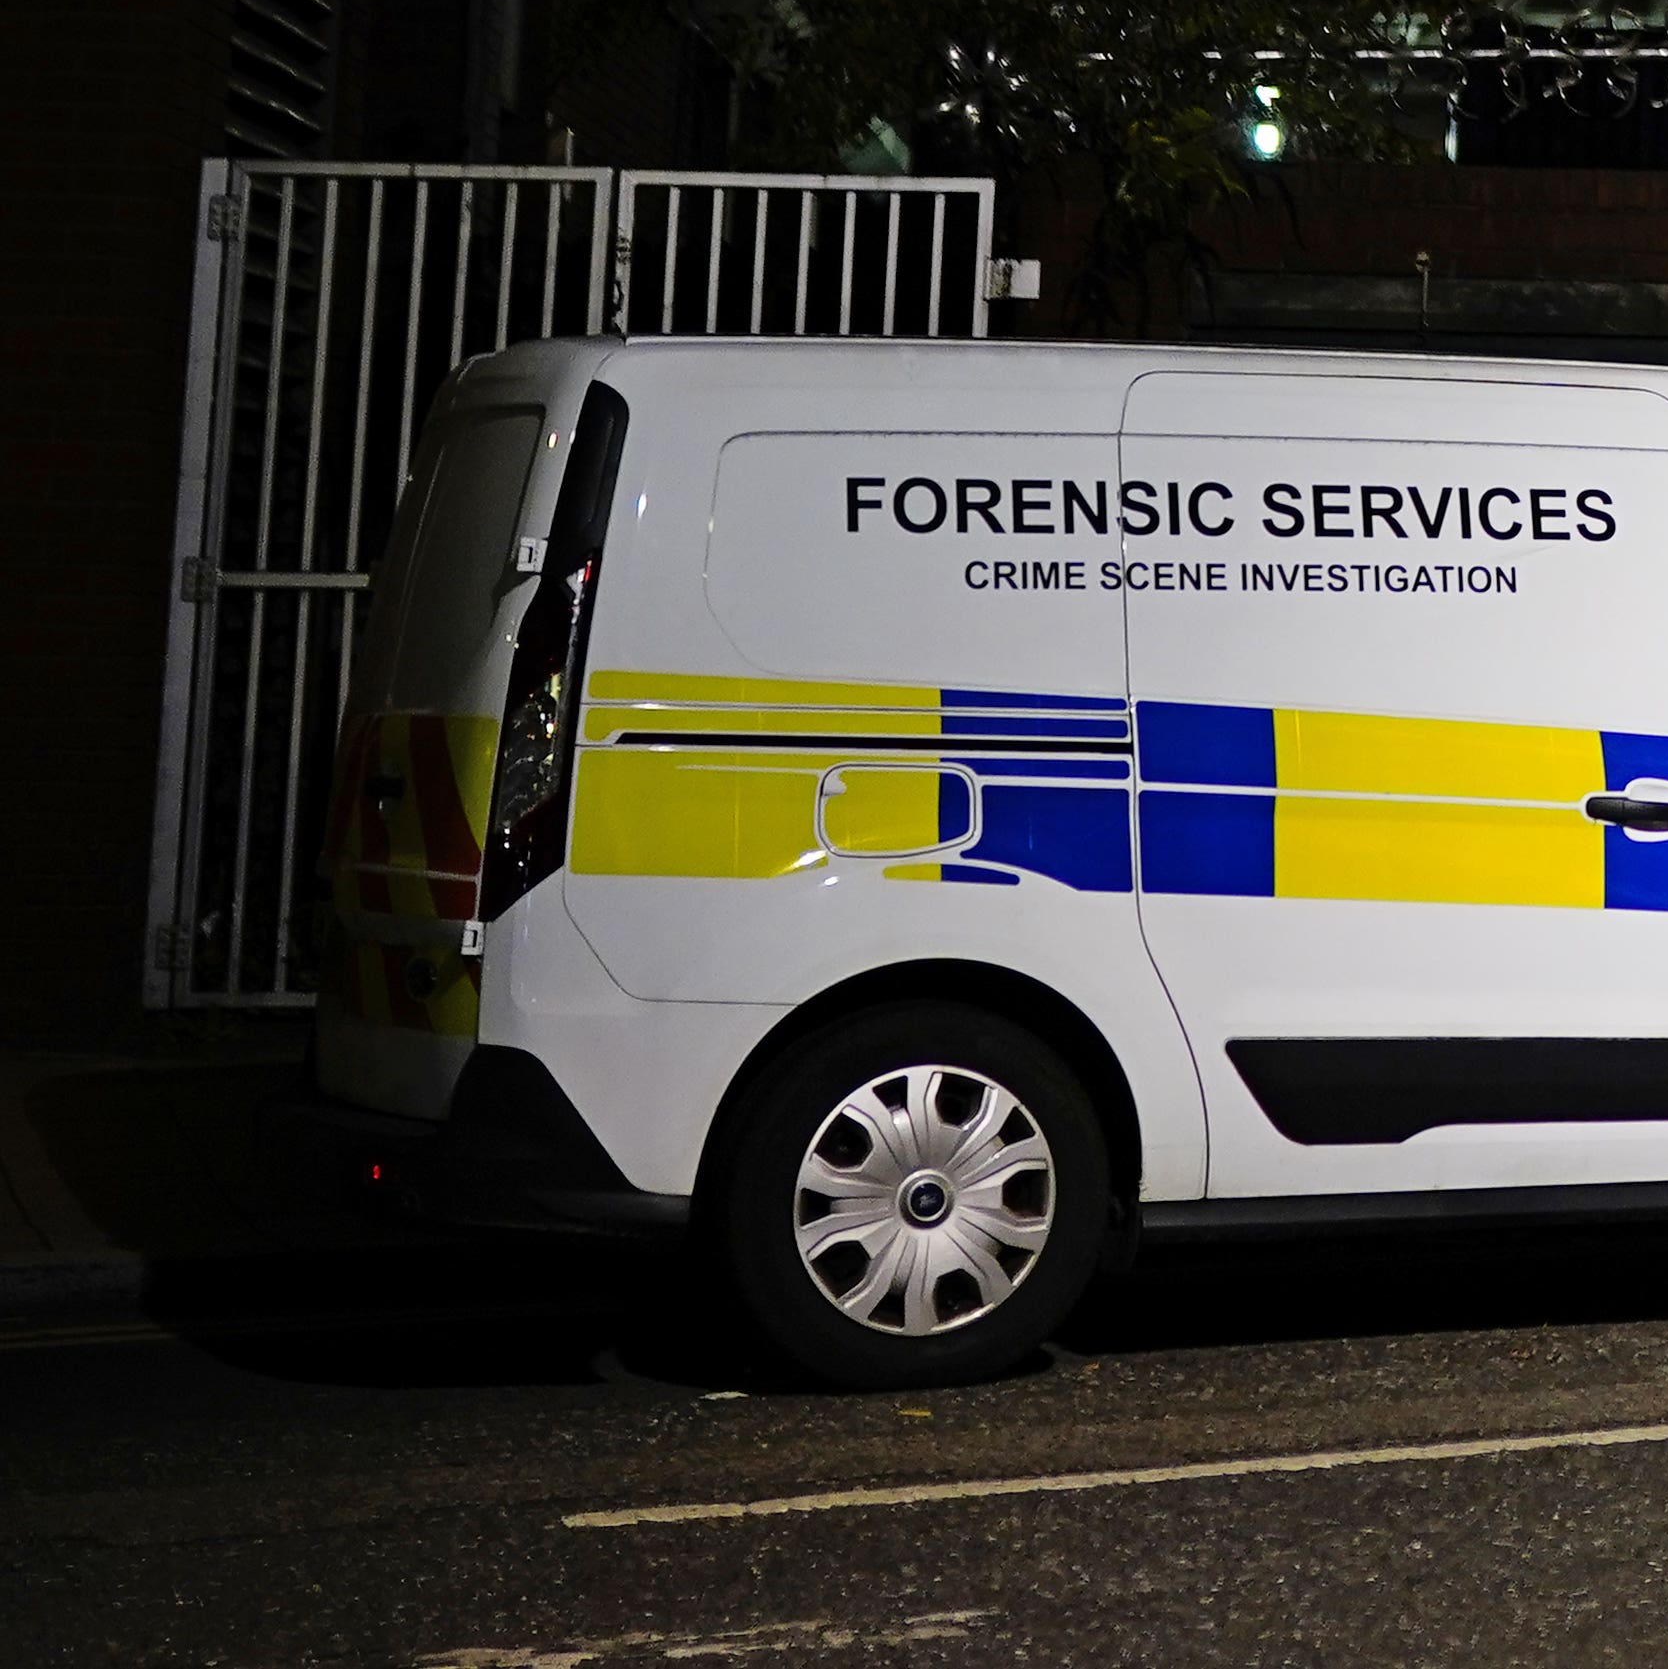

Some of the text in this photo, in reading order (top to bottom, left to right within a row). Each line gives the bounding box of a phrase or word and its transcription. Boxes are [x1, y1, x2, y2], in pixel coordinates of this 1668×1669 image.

[846, 477, 1616, 541] FORENSIC SERVICES
[963, 559, 1519, 595] CRIME SCENE INVESTIGATION
